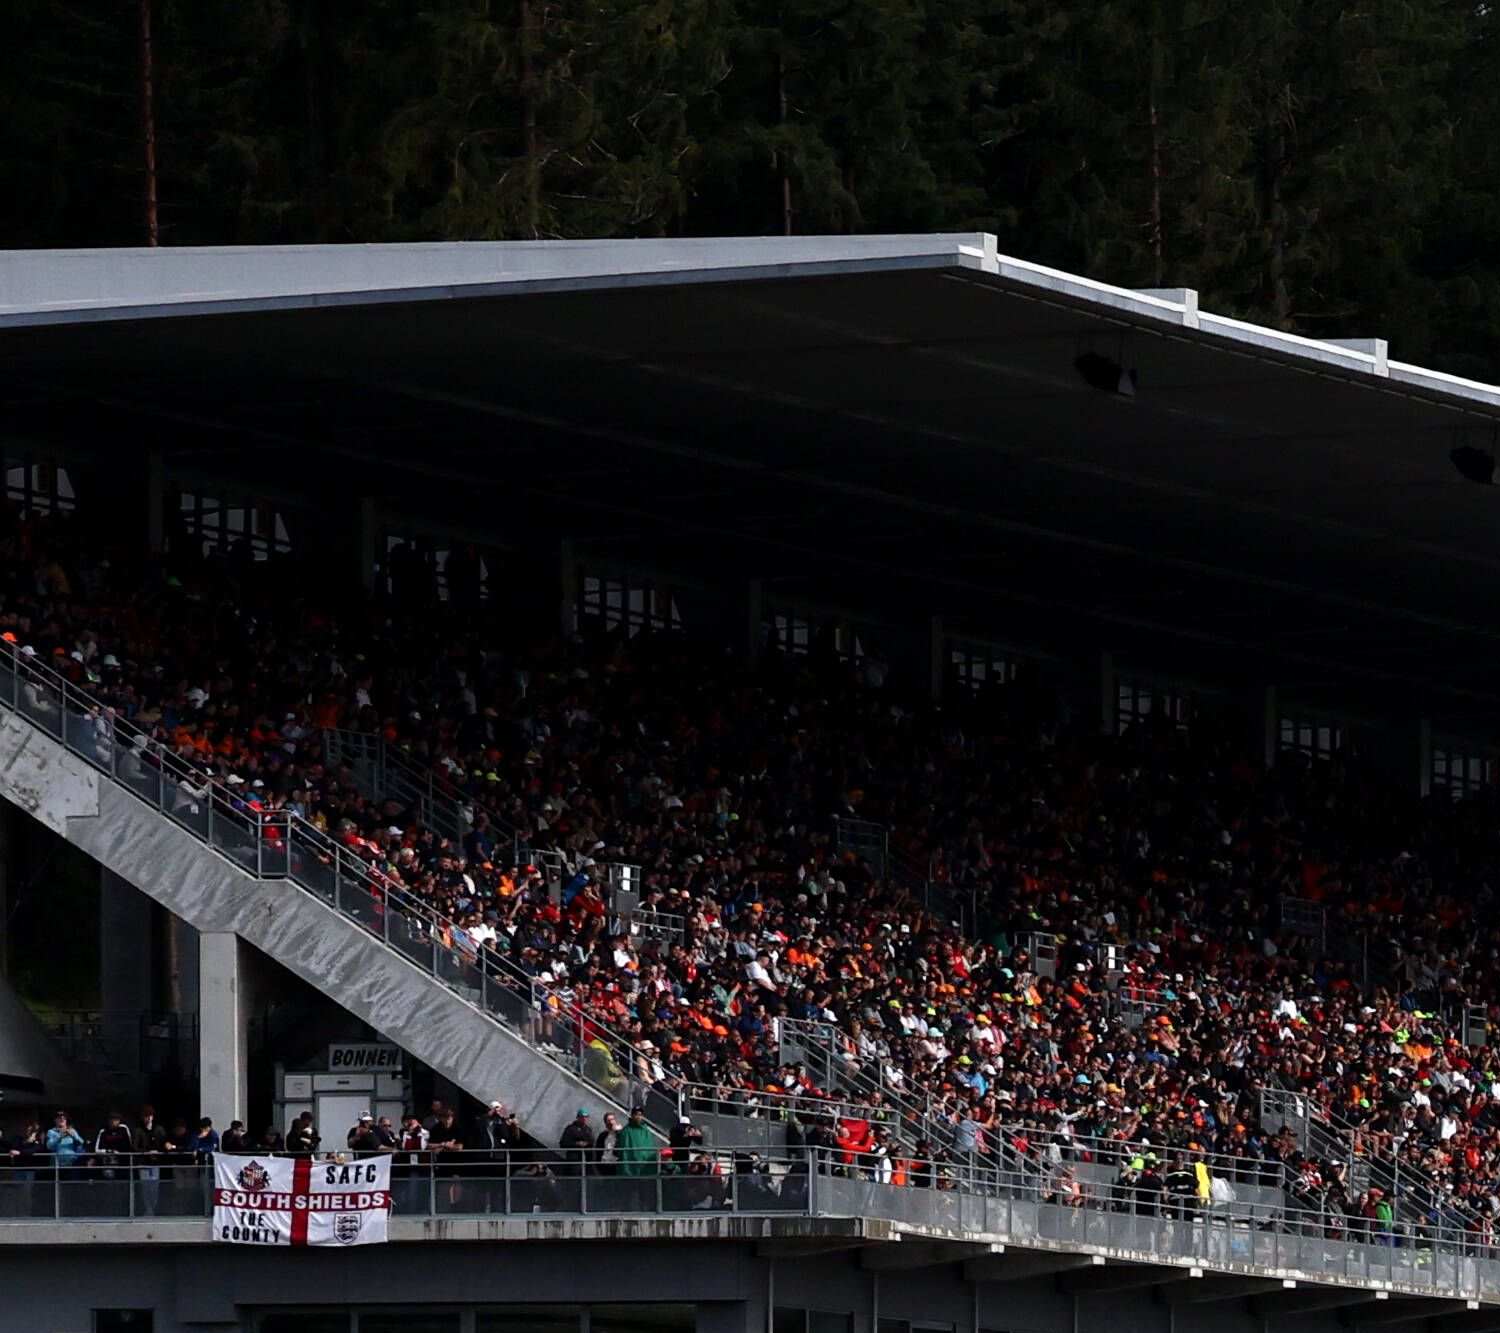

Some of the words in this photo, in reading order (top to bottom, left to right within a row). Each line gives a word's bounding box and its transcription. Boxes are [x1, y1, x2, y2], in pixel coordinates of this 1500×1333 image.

[332, 1049, 398, 1066] BONNEN
[325, 1164, 376, 1184] SAFC
[219, 1191, 290, 1209] SOUTH
[295, 1192, 385, 1210] SHIELDS
[240, 1211, 265, 1226] THE
[222, 1225, 280, 1243] COUNTY
